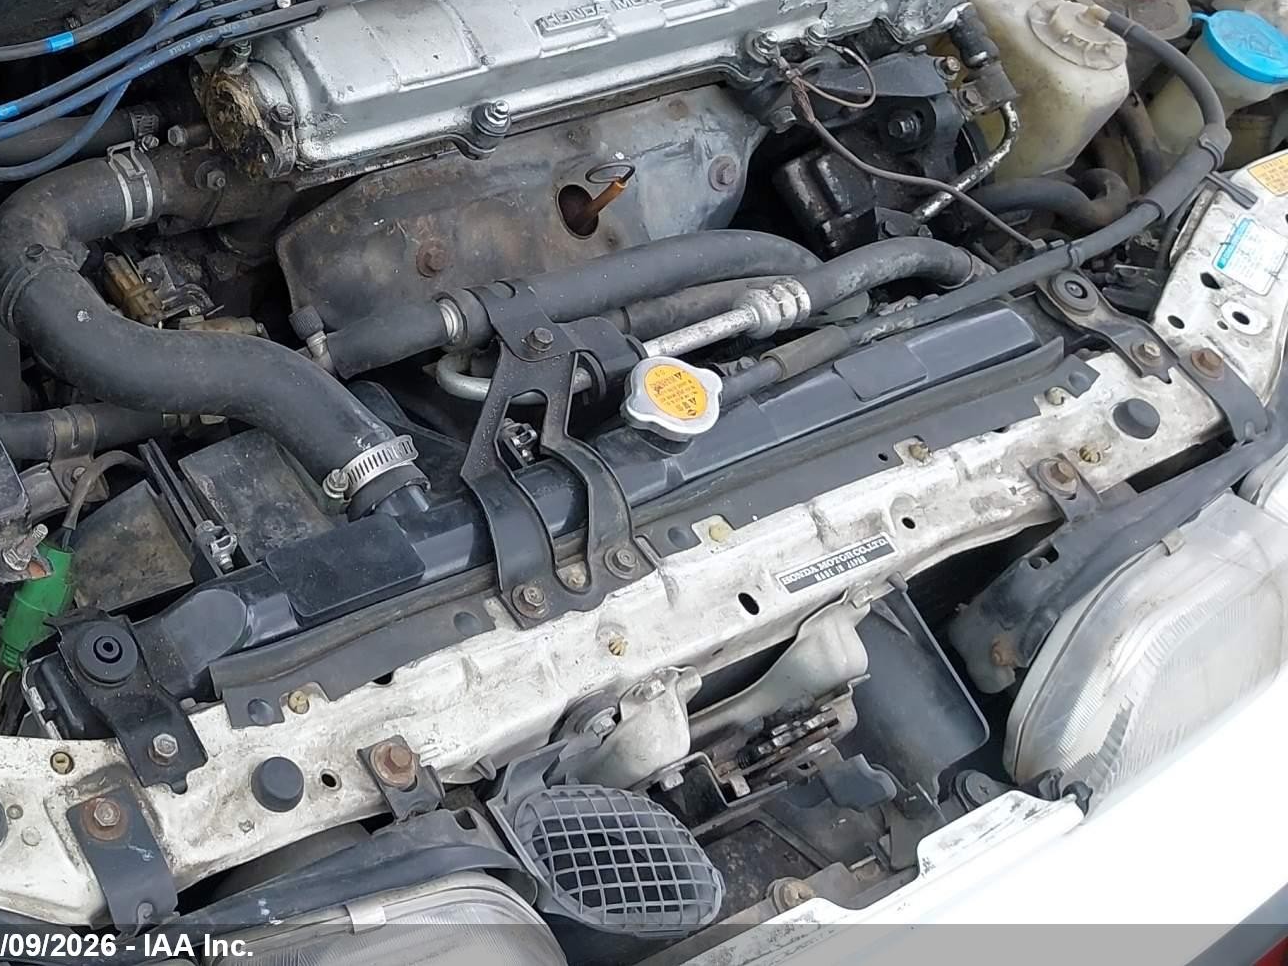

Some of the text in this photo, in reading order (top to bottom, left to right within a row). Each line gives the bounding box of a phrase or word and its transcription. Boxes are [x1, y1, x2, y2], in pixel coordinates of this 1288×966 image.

[545, 2, 607, 28] HONDA
[780, 565, 819, 585] HONDA
[816, 552, 853, 571] MOTOR
